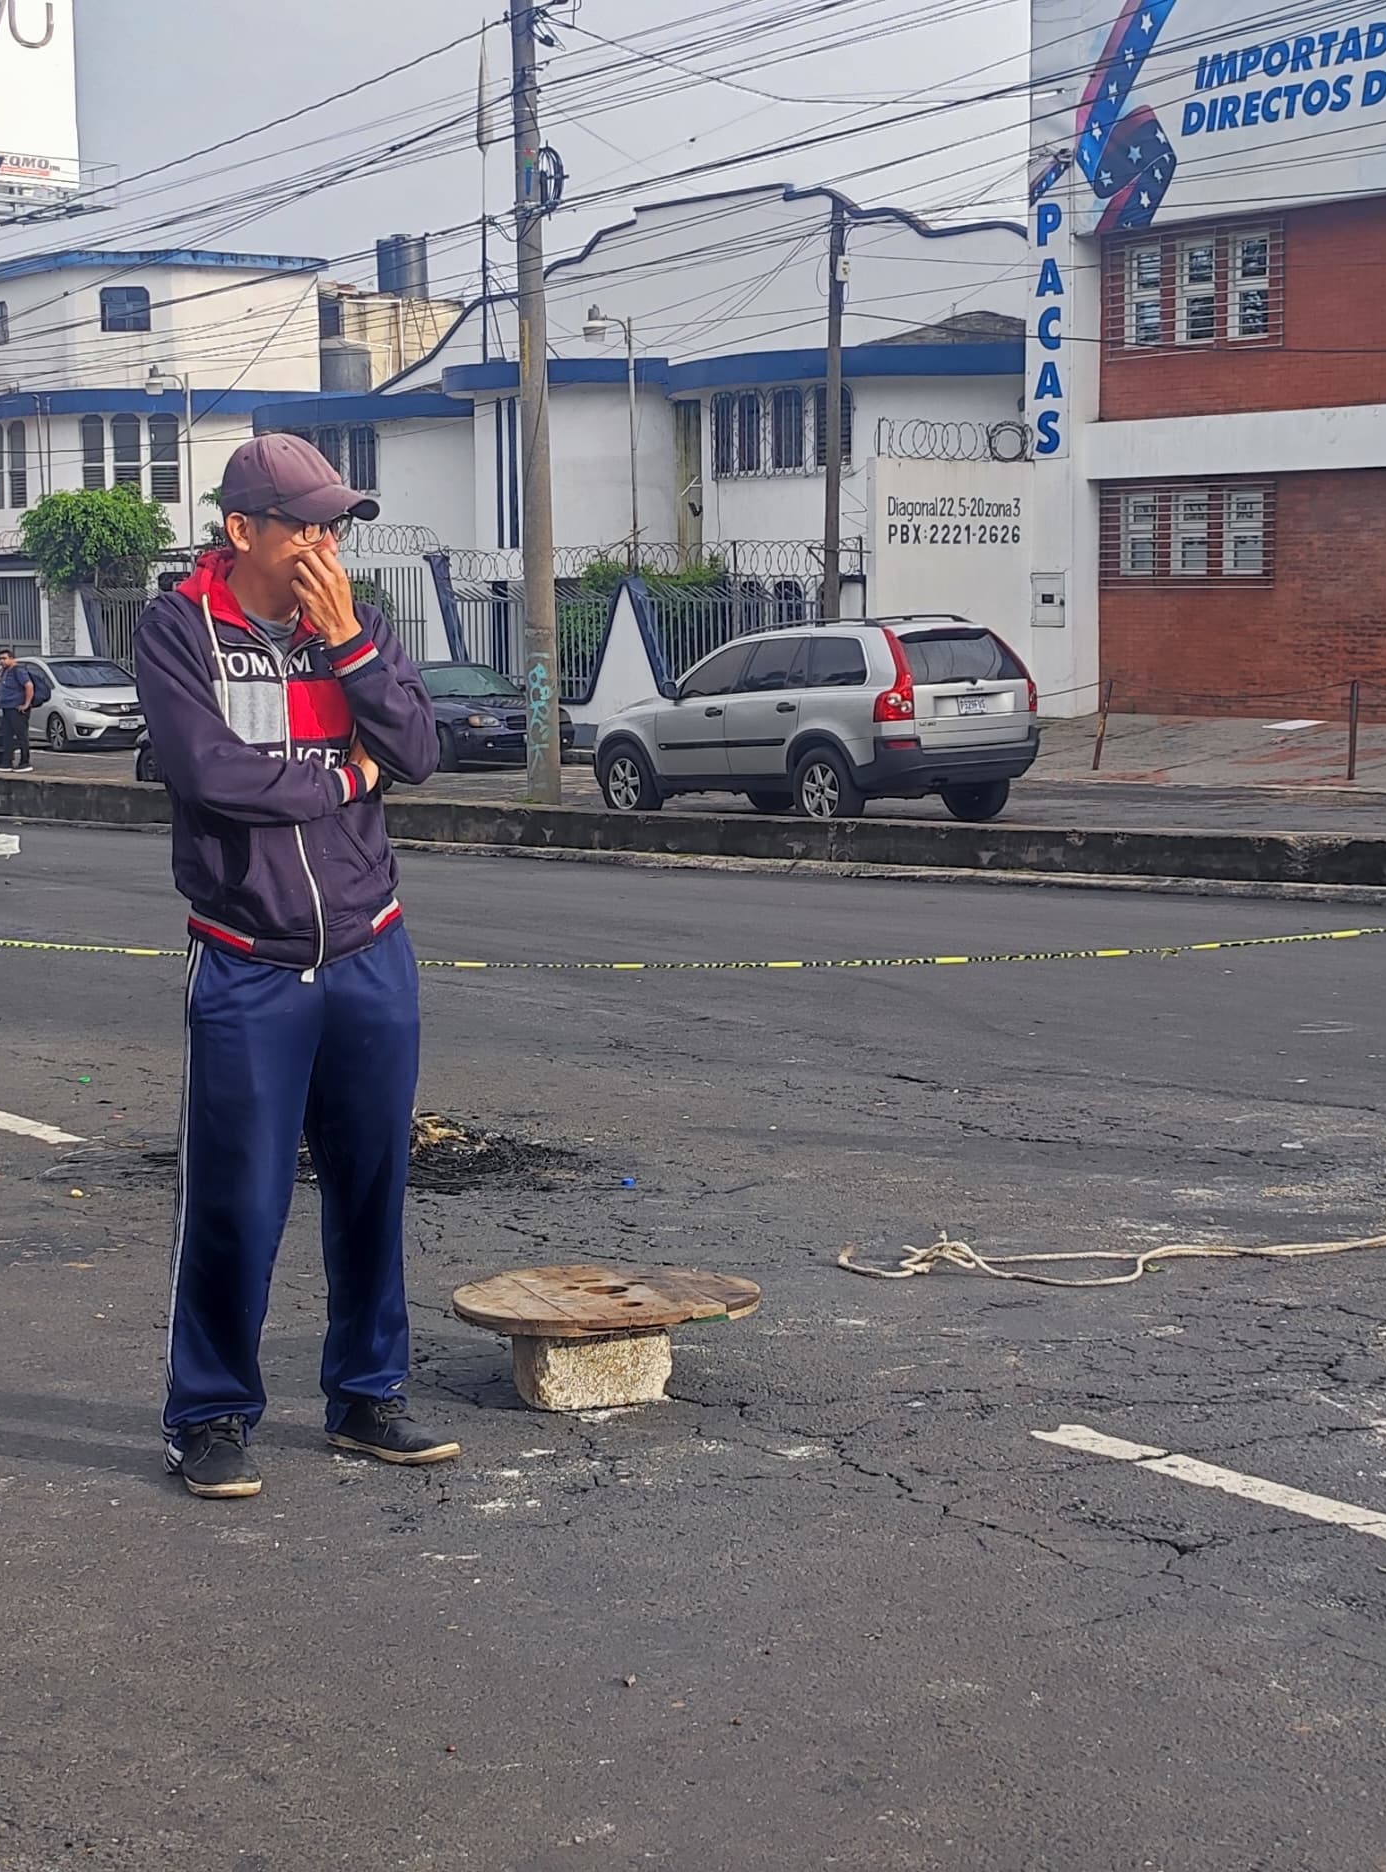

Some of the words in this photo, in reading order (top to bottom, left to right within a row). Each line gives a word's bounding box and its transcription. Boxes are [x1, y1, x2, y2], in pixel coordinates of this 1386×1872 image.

[1181, 74, 1353, 137] DIRECTOS
[1034, 203, 1064, 455] PACAS
[887, 496, 938, 522] Diagonal
[984, 501, 1012, 518] zona
[1012, 498, 1021, 518] 3
